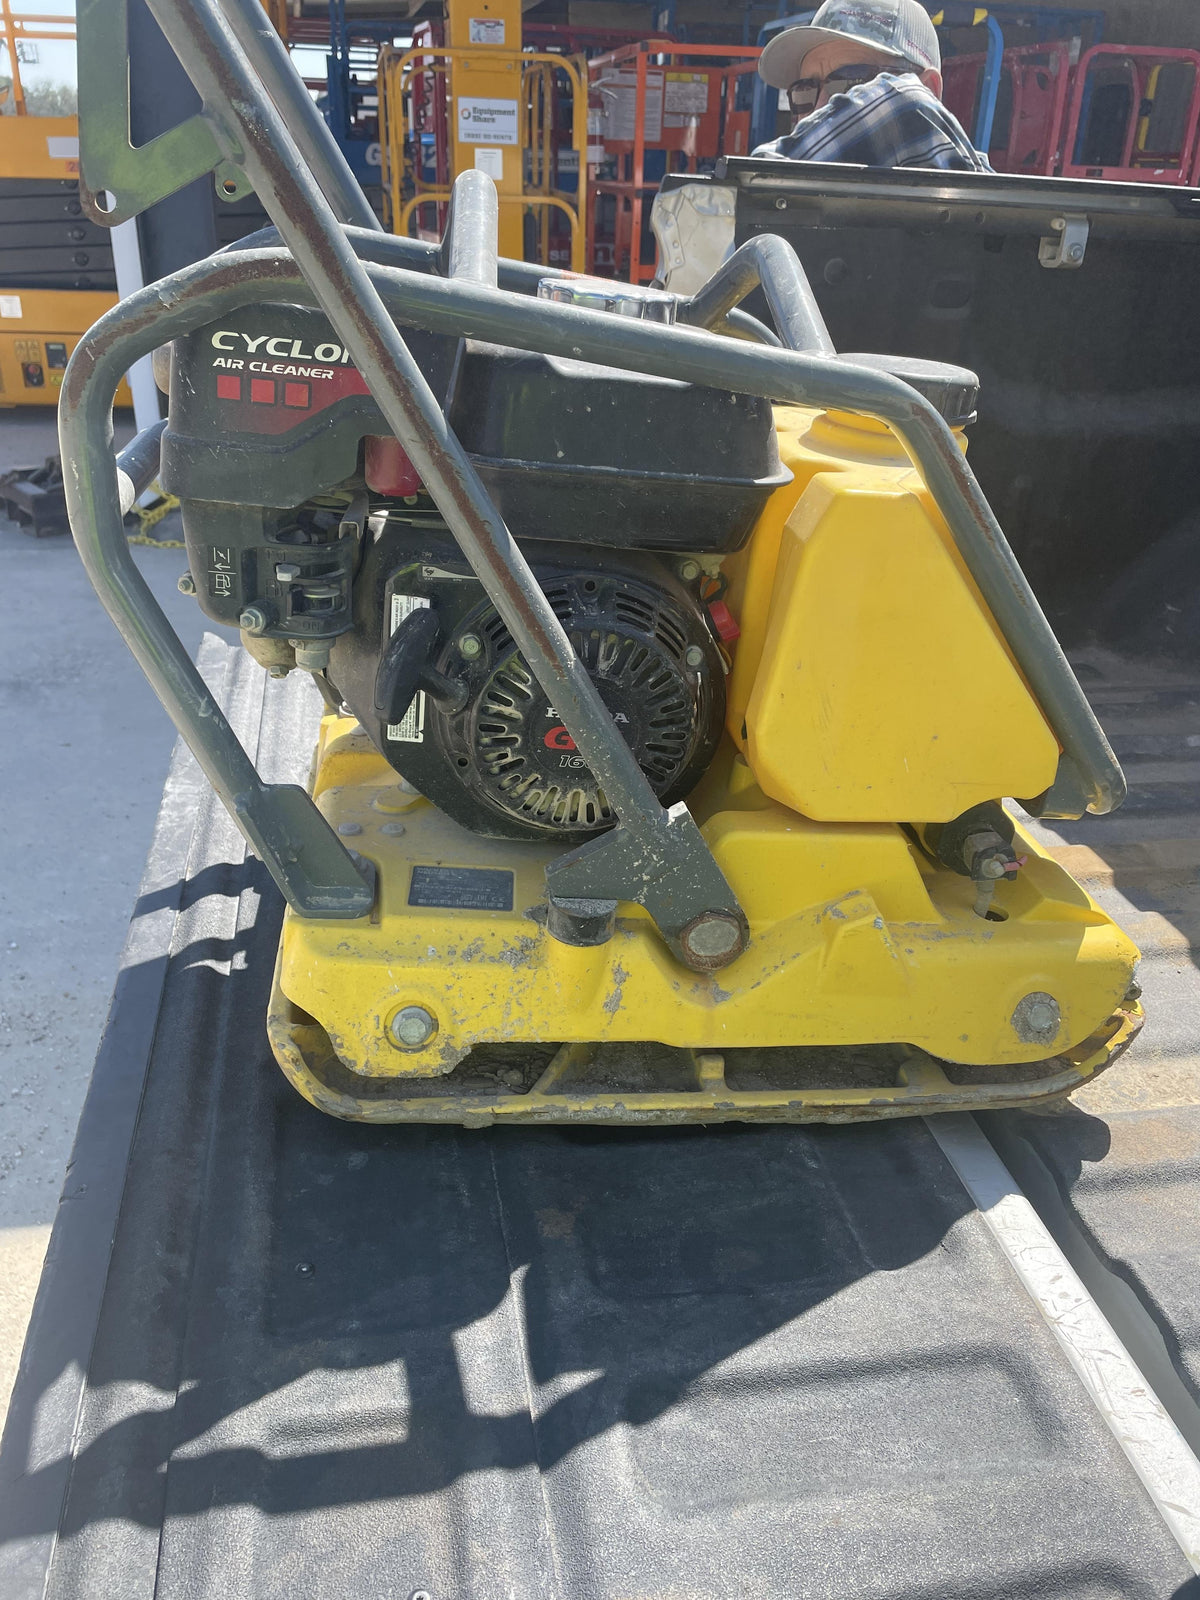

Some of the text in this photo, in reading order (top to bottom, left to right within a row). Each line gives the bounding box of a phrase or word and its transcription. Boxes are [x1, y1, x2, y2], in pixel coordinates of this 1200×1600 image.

[472, 107, 515, 116] Equipment
[211, 330, 350, 364] CYCLO
[212, 357, 334, 380] AIR CLEANER
[543, 726, 577, 750] G
[559, 754, 590, 768] 16
